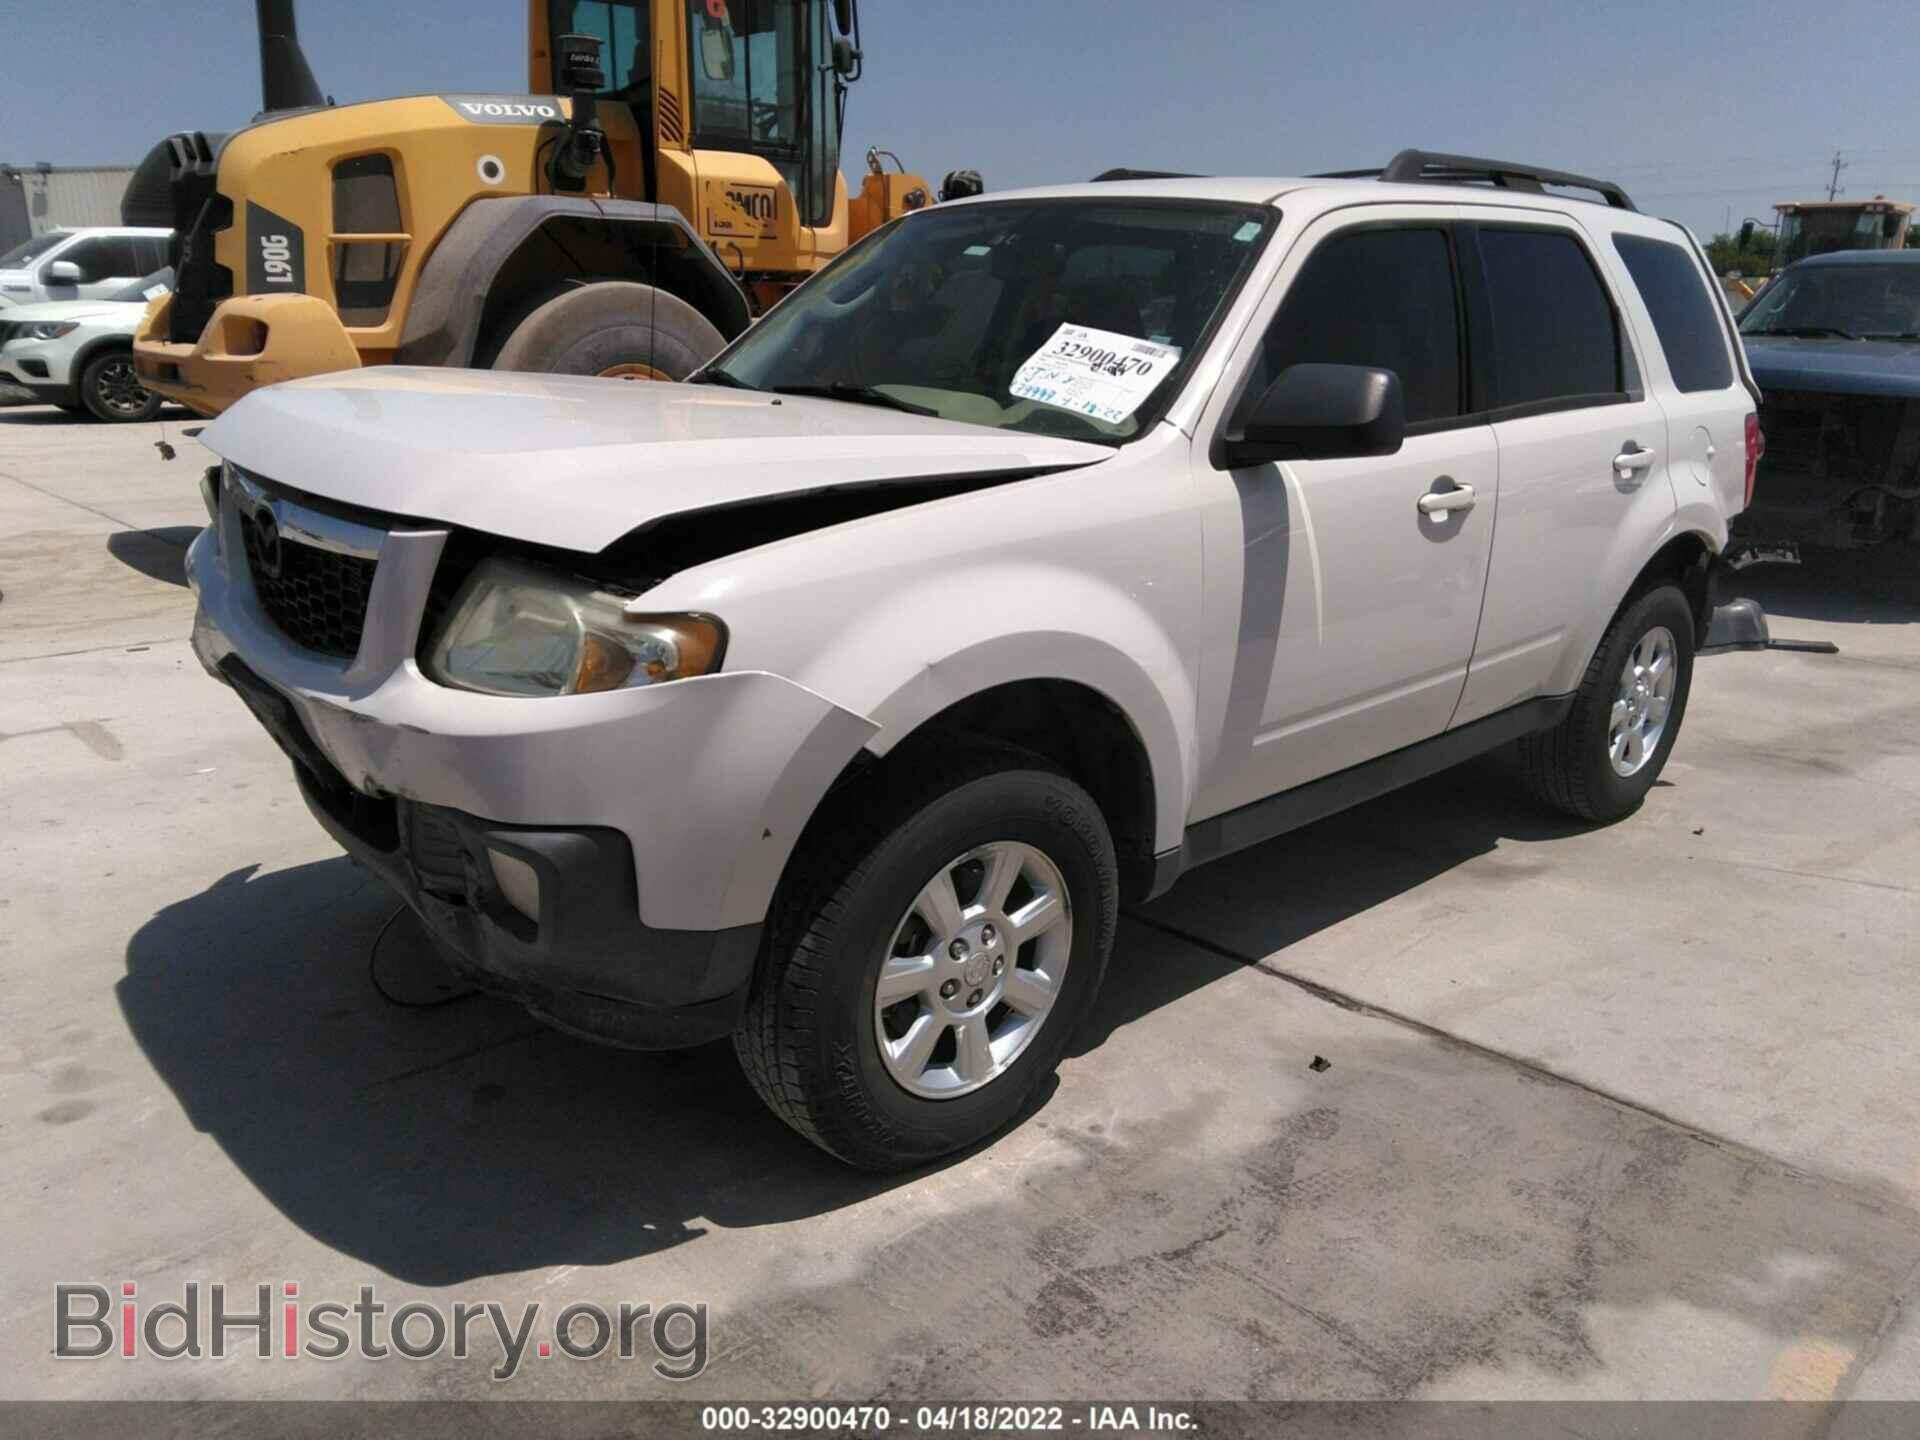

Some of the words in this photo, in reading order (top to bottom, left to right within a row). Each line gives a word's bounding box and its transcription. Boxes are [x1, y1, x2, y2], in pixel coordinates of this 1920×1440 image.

[460, 103, 555, 118] VOLVO
[261, 234, 293, 282] L90G
[1052, 341, 1152, 376] 32900470
